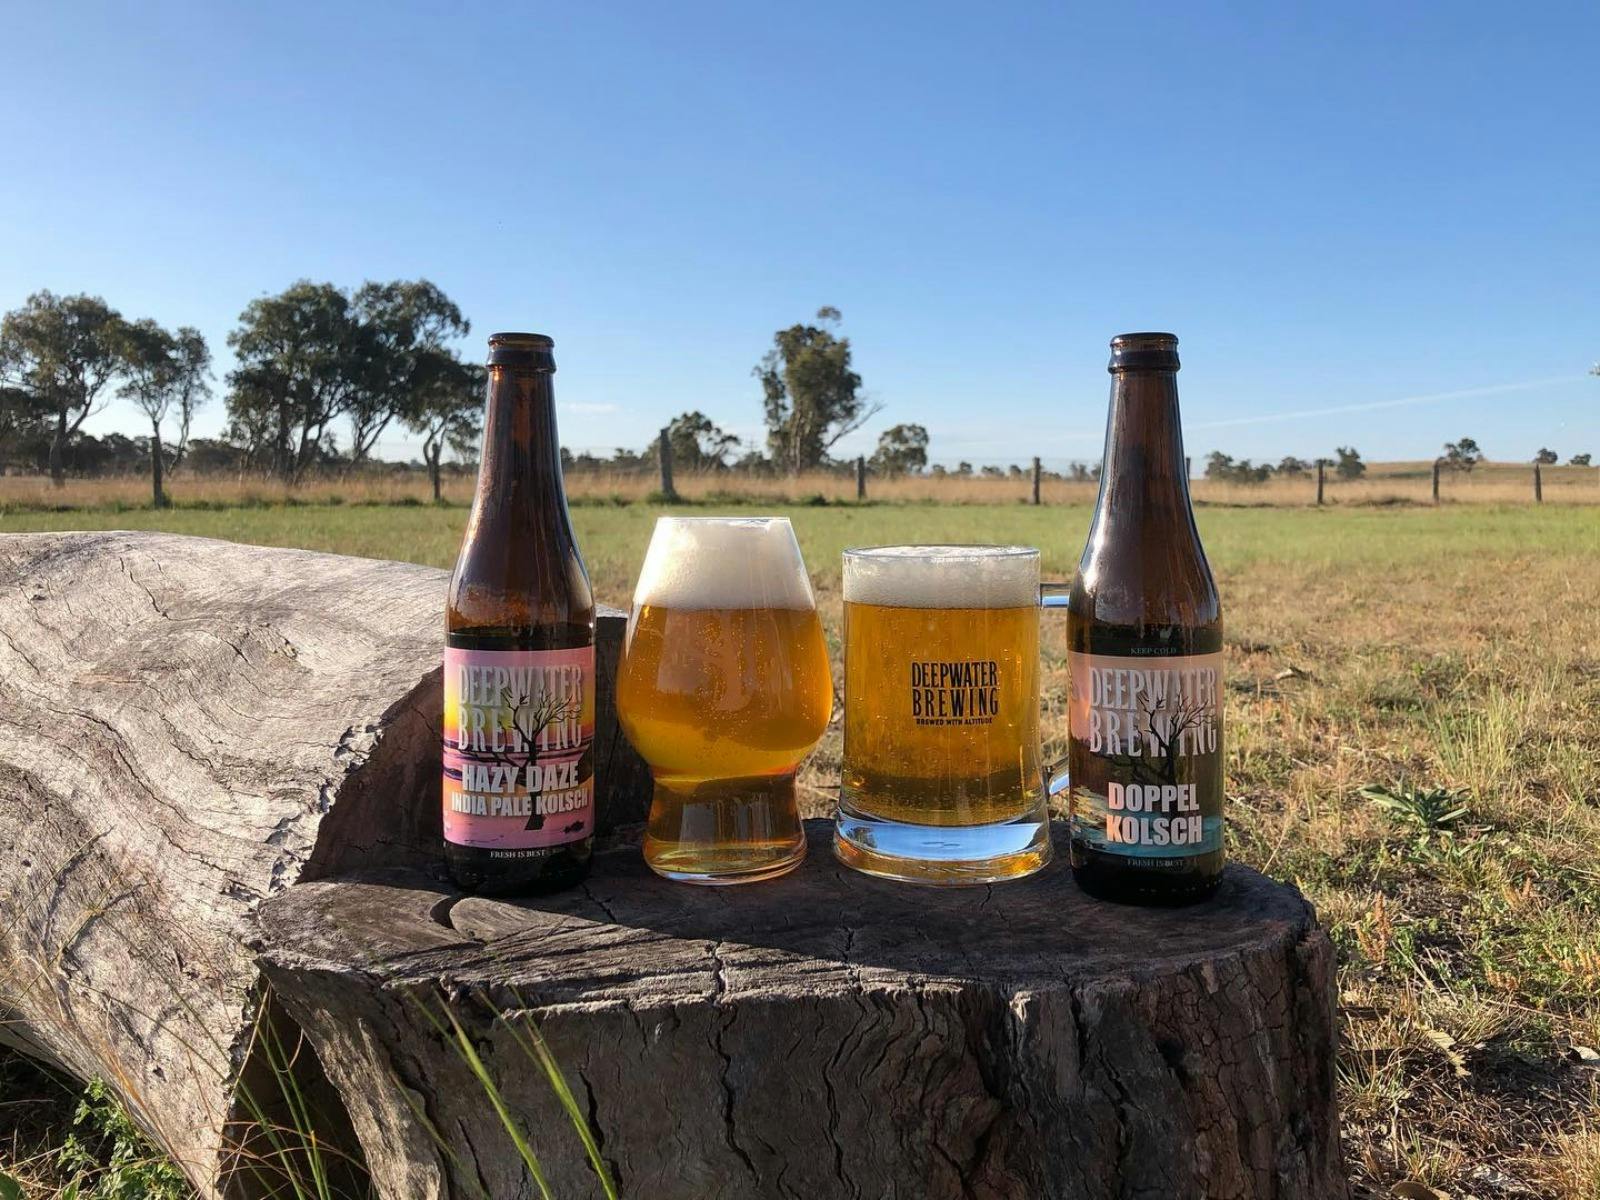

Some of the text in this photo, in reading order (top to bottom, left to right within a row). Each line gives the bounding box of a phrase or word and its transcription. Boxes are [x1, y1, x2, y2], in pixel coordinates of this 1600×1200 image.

[458, 664, 582, 706] DEEPWATER
[912, 661, 998, 688] DEEPWATER
[1089, 667, 1216, 710] DEEPWATER
[912, 687, 999, 717] BREWING
[458, 704, 582, 753] BREWING
[916, 717, 993, 726] BREWED WITH ALTITUDE
[1089, 708, 1217, 758] BREWING
[462, 760, 579, 793] HAZY DAZE
[451, 788, 588, 817] INDIA PALE KOLSCH
[1108, 781, 1200, 812] DOPPEL
[1106, 814, 1203, 846] KOLSCH
[490, 849, 546, 859] FRESH IS BEST
